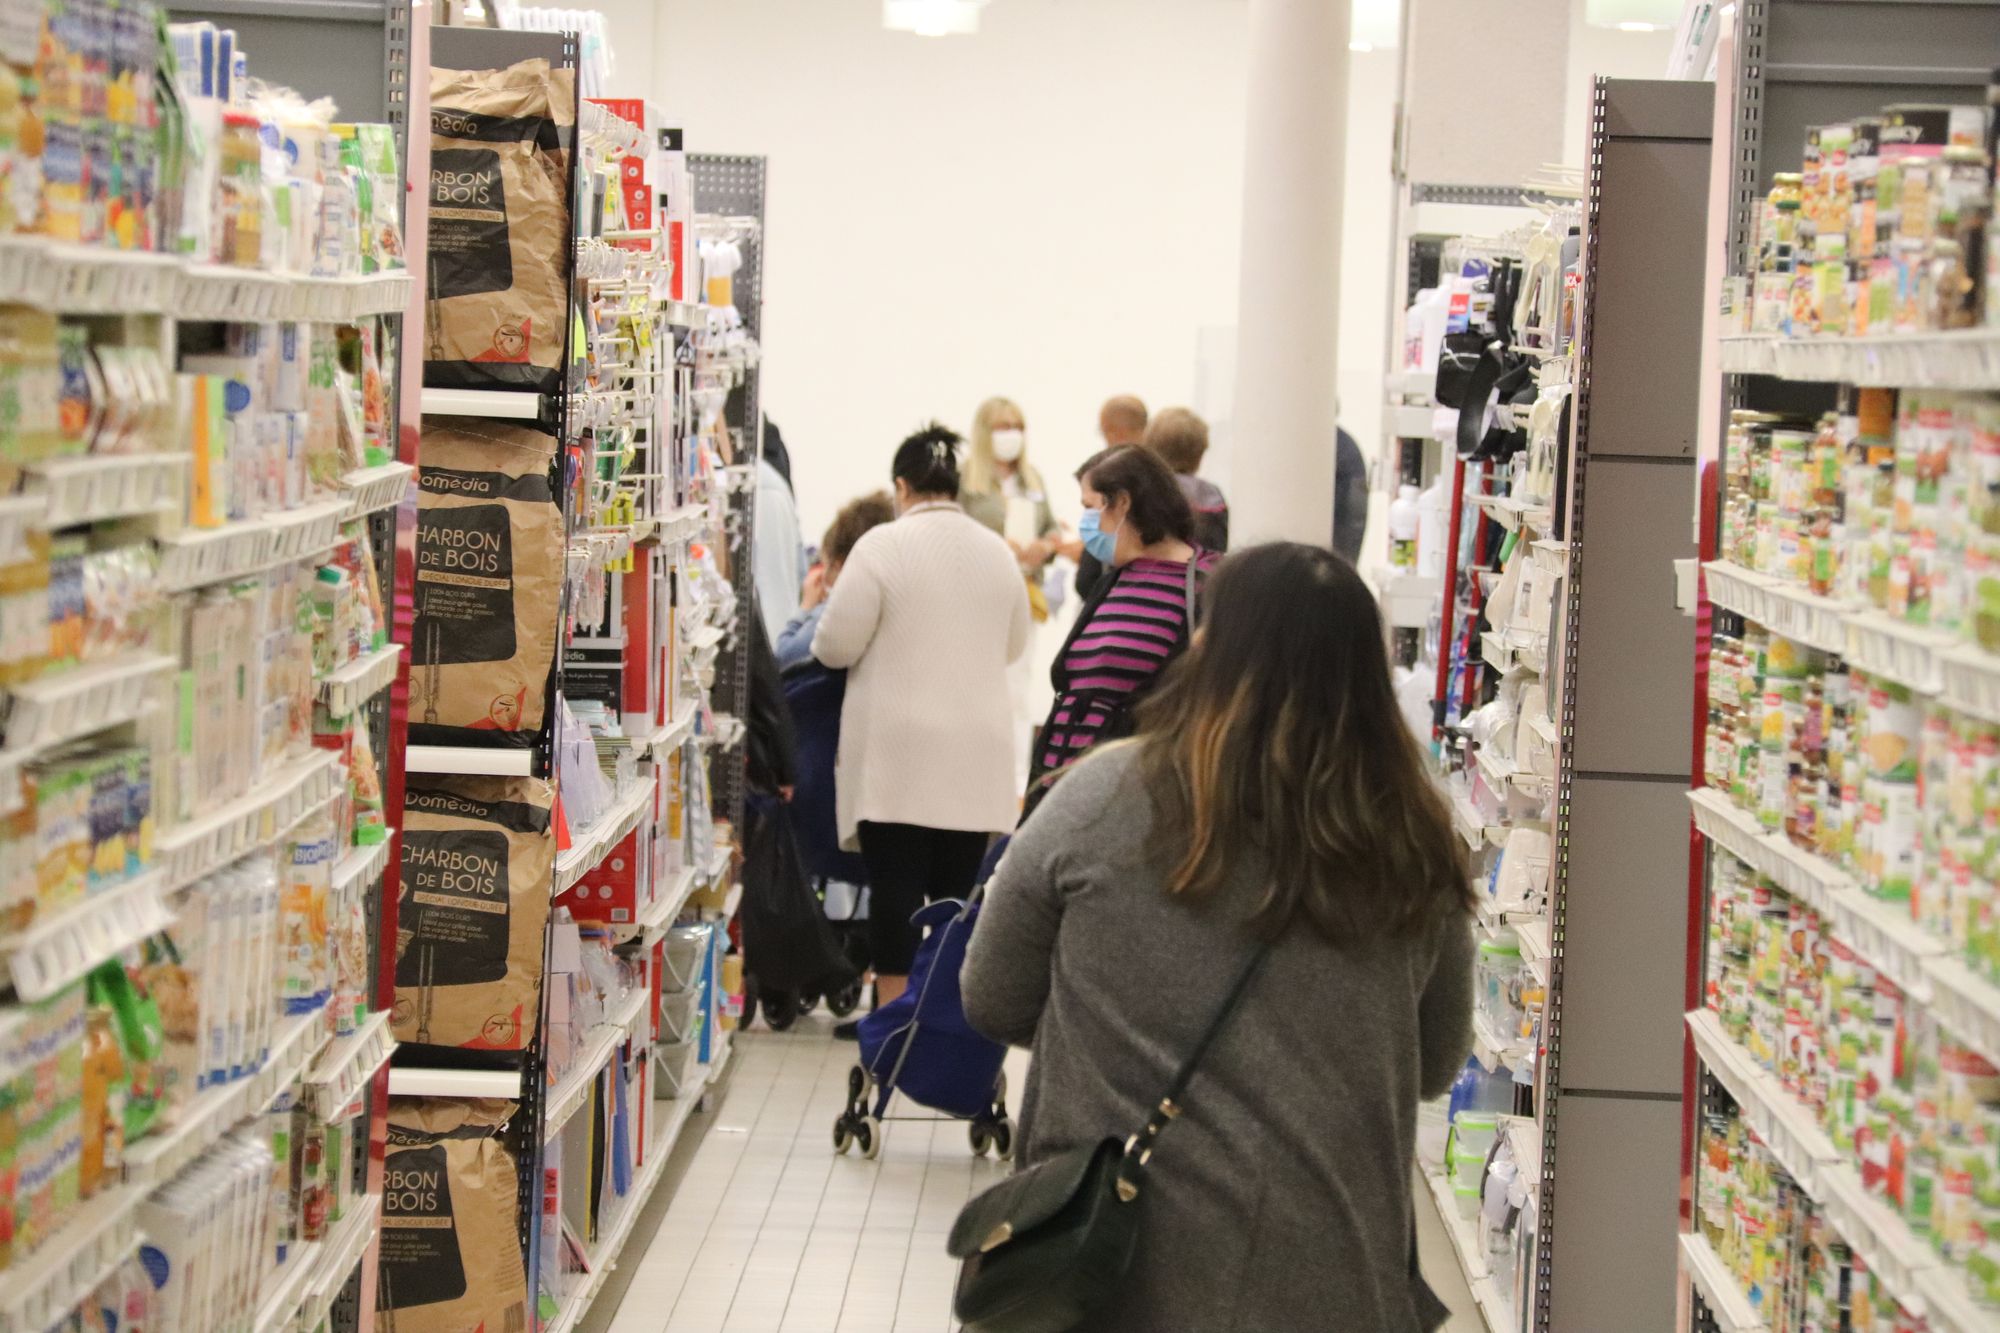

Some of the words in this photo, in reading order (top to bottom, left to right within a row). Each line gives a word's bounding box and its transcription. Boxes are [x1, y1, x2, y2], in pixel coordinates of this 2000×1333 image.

[437, 185, 490, 204] BOIS
[419, 476, 489, 492] omédia
[420, 551, 440, 565] DE
[445, 549, 498, 572] BOIS
[400, 845, 498, 877] CHARBON
[416, 873, 436, 887] DE
[441, 872, 494, 895] BOIS
[387, 1192, 437, 1211] BOIS
